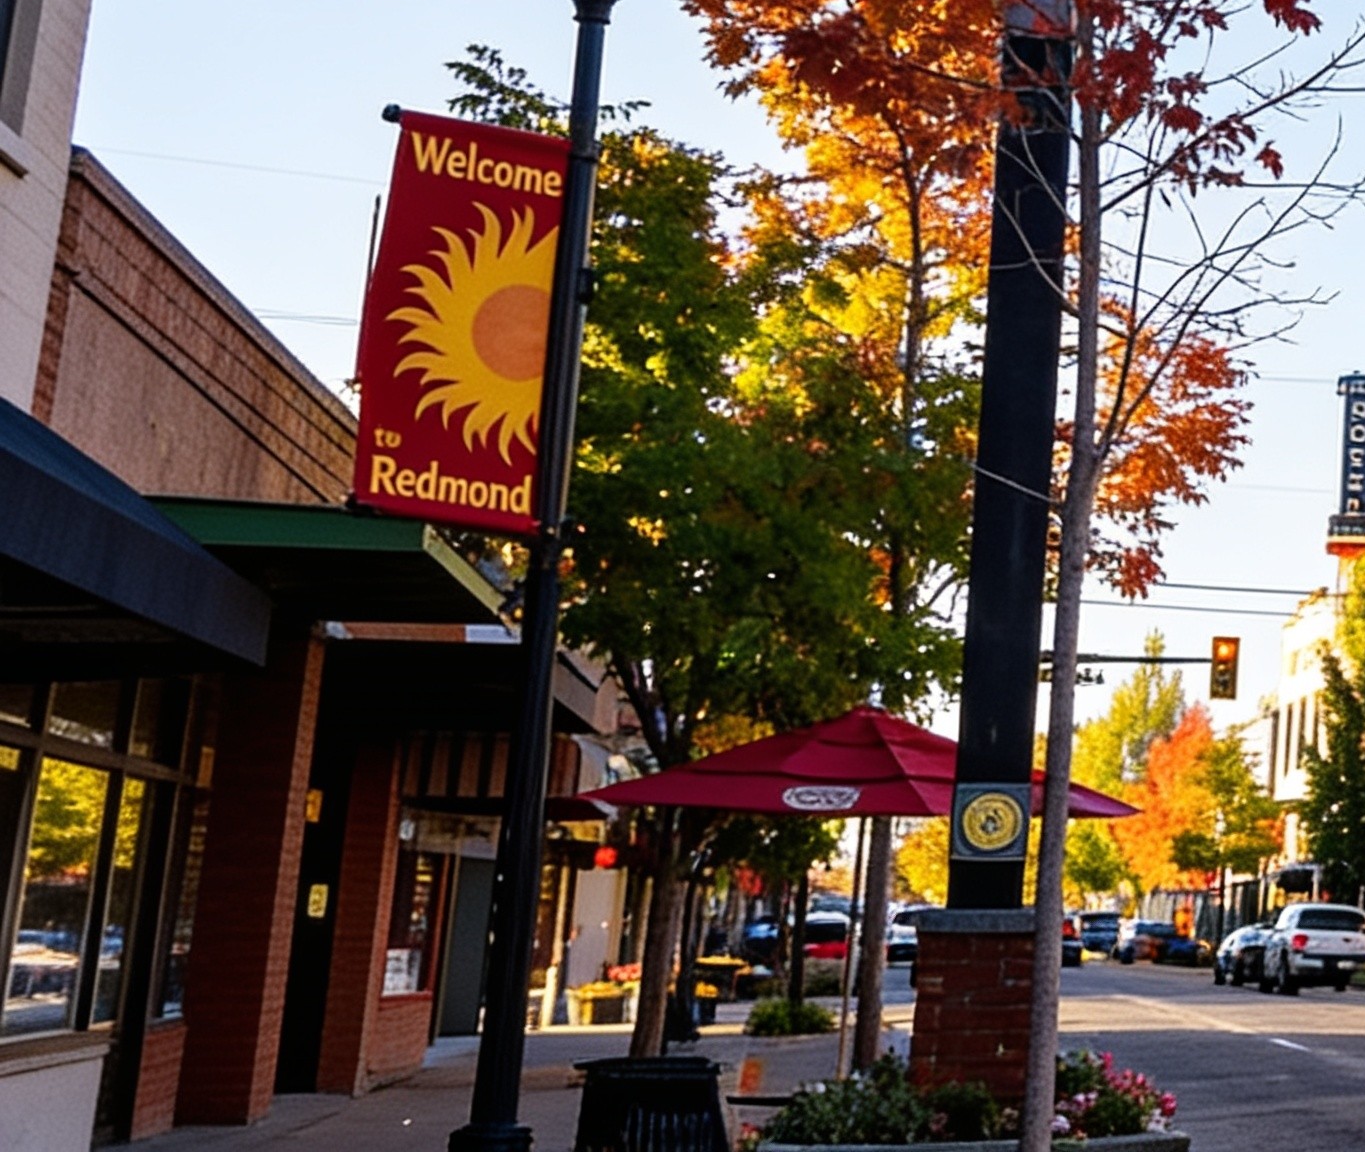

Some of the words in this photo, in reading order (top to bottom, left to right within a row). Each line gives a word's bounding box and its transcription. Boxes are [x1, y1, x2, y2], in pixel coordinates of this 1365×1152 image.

[411, 132, 562, 196] Welcome
[375, 428, 401, 448] to
[371, 456, 532, 514] Redmond
